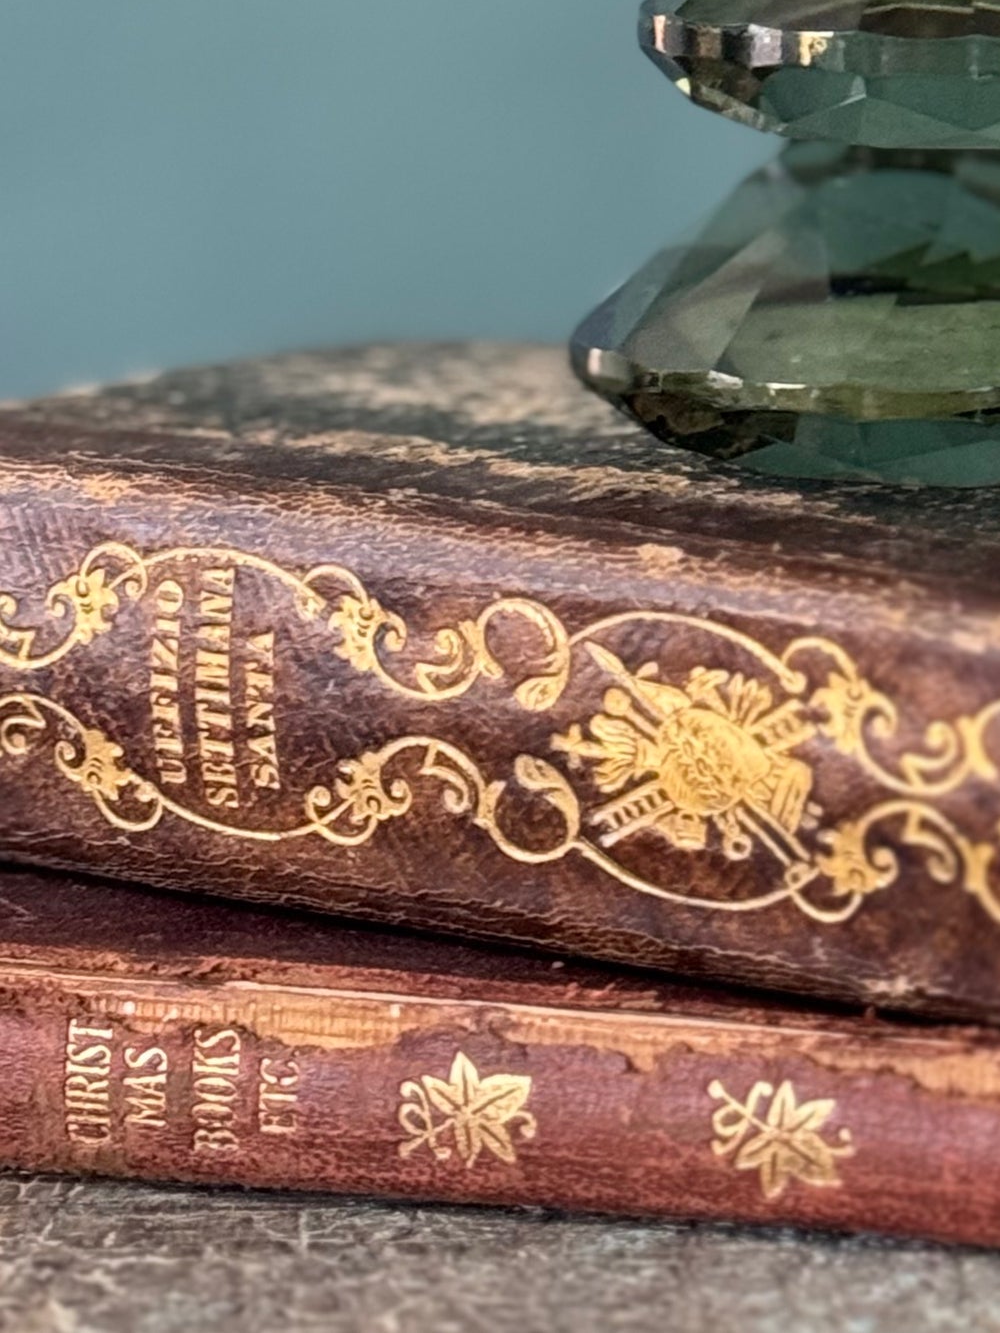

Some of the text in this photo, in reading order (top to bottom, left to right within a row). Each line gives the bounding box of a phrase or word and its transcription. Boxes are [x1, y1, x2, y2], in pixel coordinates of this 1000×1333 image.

[195, 567, 239, 808] SETTIMANA
[245, 632, 281, 789] SANTA
[65, 1018, 113, 1144] CHRIST
[123, 1047, 167, 1126] MAS
[192, 1029, 241, 1151] BOOKS
